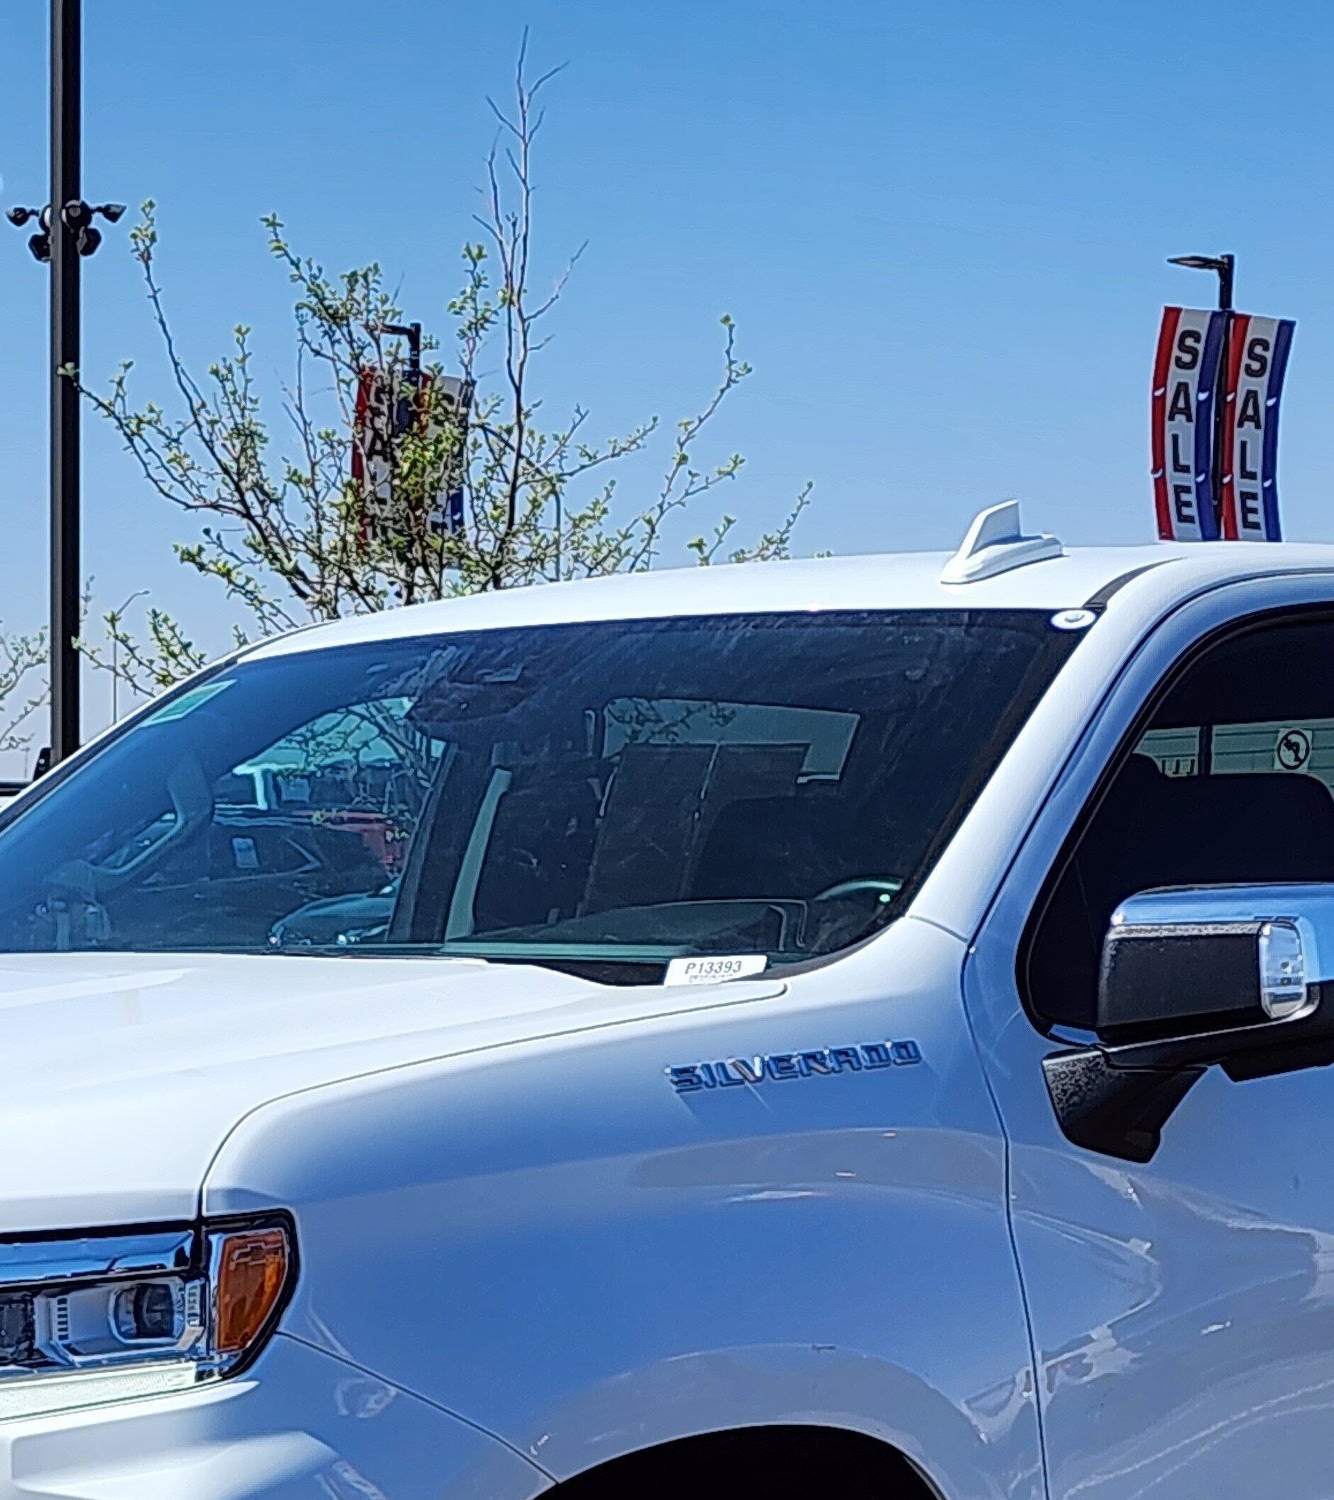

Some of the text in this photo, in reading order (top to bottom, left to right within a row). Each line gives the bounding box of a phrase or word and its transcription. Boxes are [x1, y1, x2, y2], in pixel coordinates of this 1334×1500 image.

[1167, 329, 1202, 525] SALE
[1236, 337, 1271, 531] SALE
[684, 961, 742, 974] P13393
[668, 1039, 923, 1093] SILVERADO
